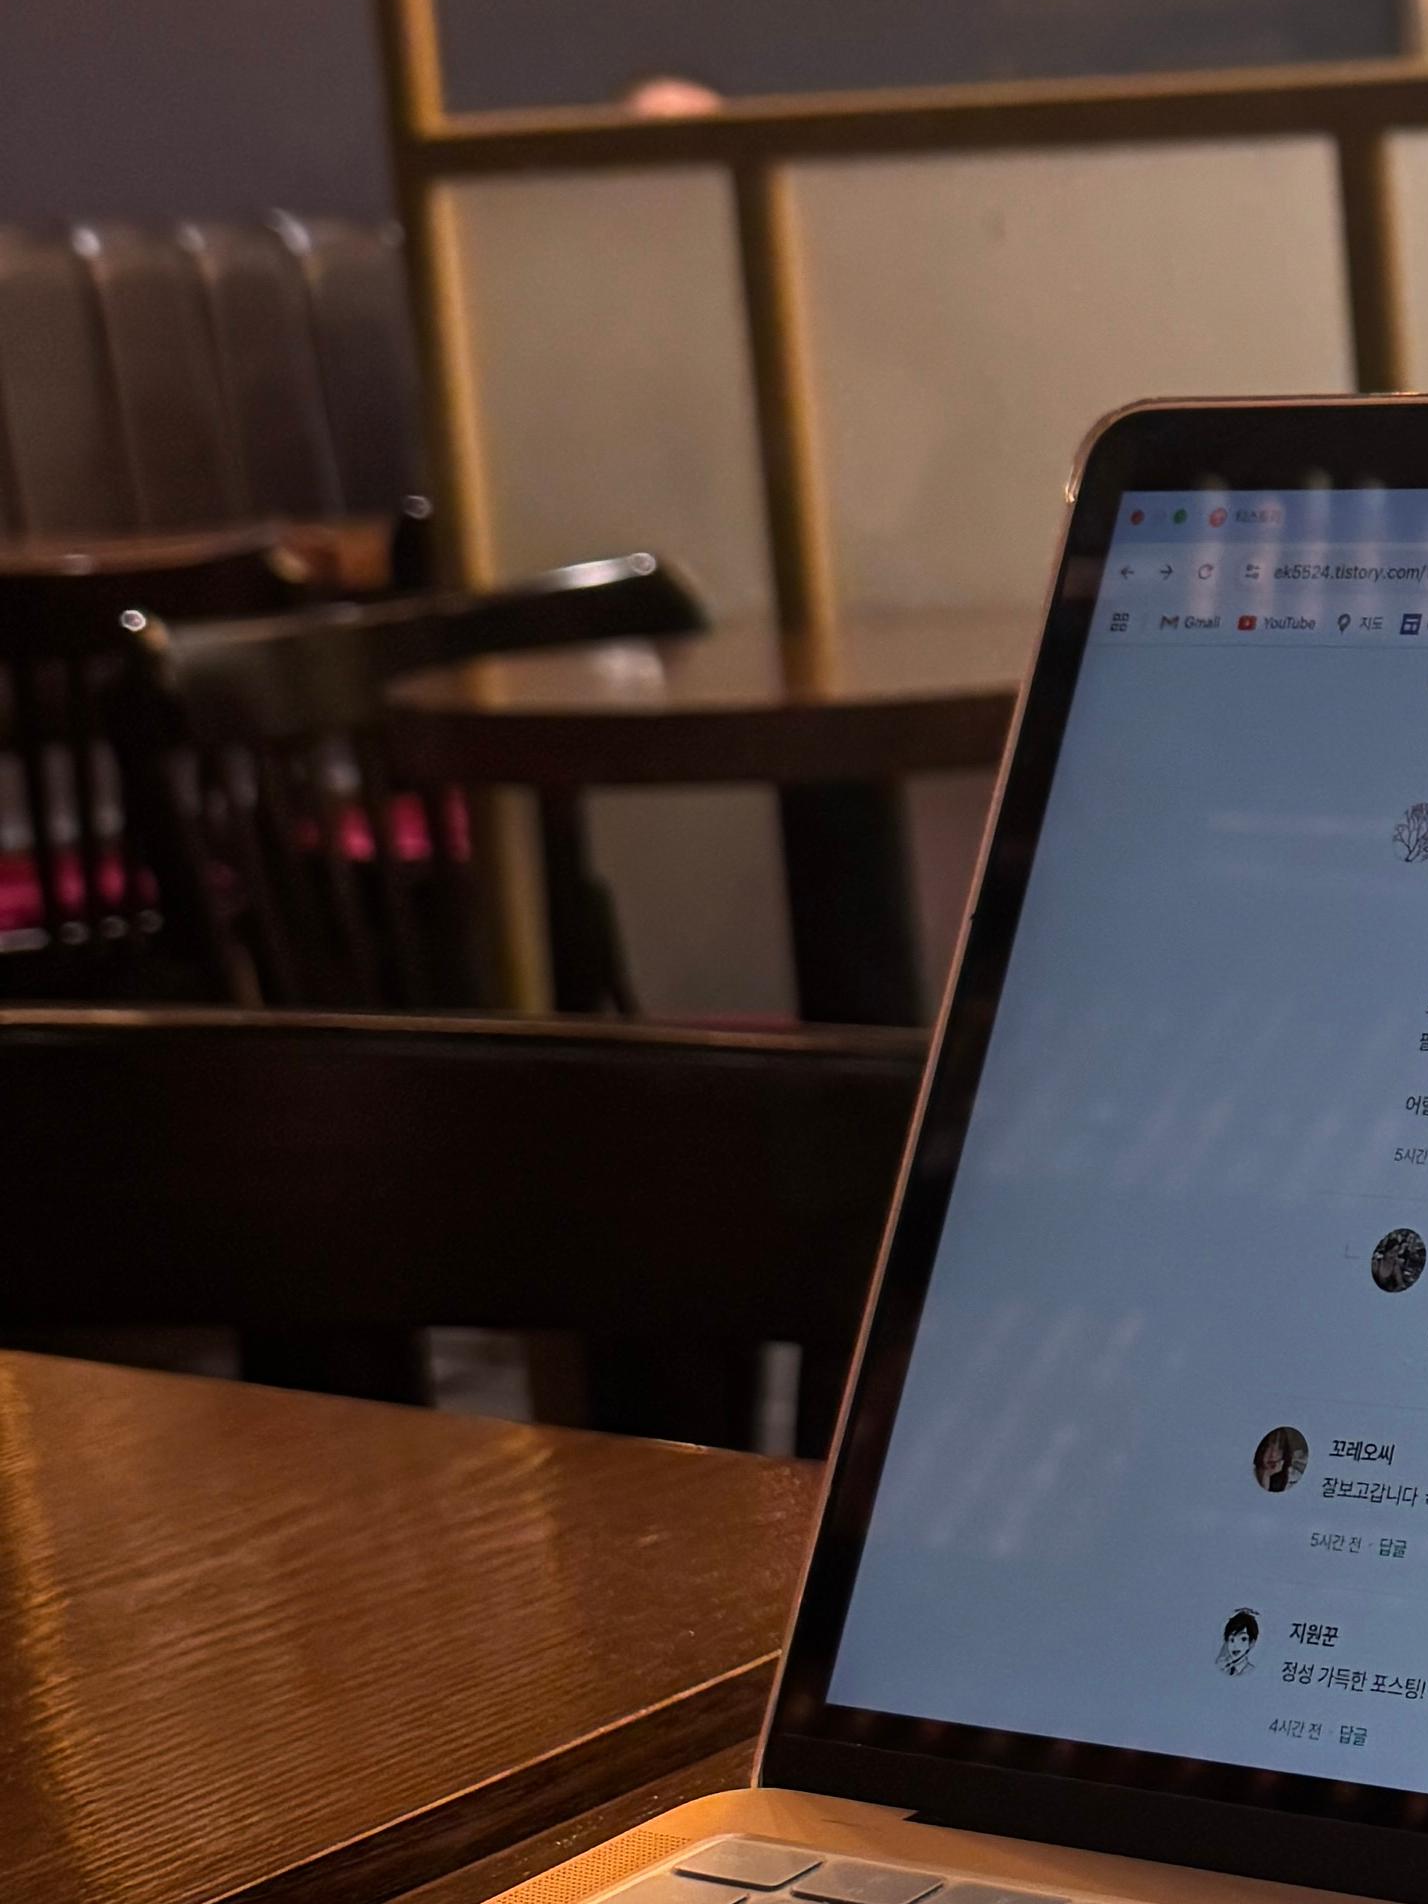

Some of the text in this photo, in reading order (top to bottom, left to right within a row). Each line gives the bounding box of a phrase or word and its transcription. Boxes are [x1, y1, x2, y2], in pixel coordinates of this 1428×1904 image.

[1184, 615, 1220, 629] Gmail
[1263, 616, 1316, 631] YouTube
[1358, 615, 1384, 631] 지도
[1394, 1147, 1428, 1165] 5시간
[1328, 1438, 1396, 1466] 꼬레오씨
[1321, 1476, 1420, 1509] 잘보고갑니다
[1310, 1531, 1408, 1560] 5시간 전 답글
[1288, 1620, 1342, 1649] 지원꾼
[1281, 1659, 1316, 1686] 정성
[1316, 1666, 1368, 1694] 가득한
[1370, 1673, 1426, 1702] 포스팅!
[1268, 1718, 1368, 1747] 4시간 전 답글
